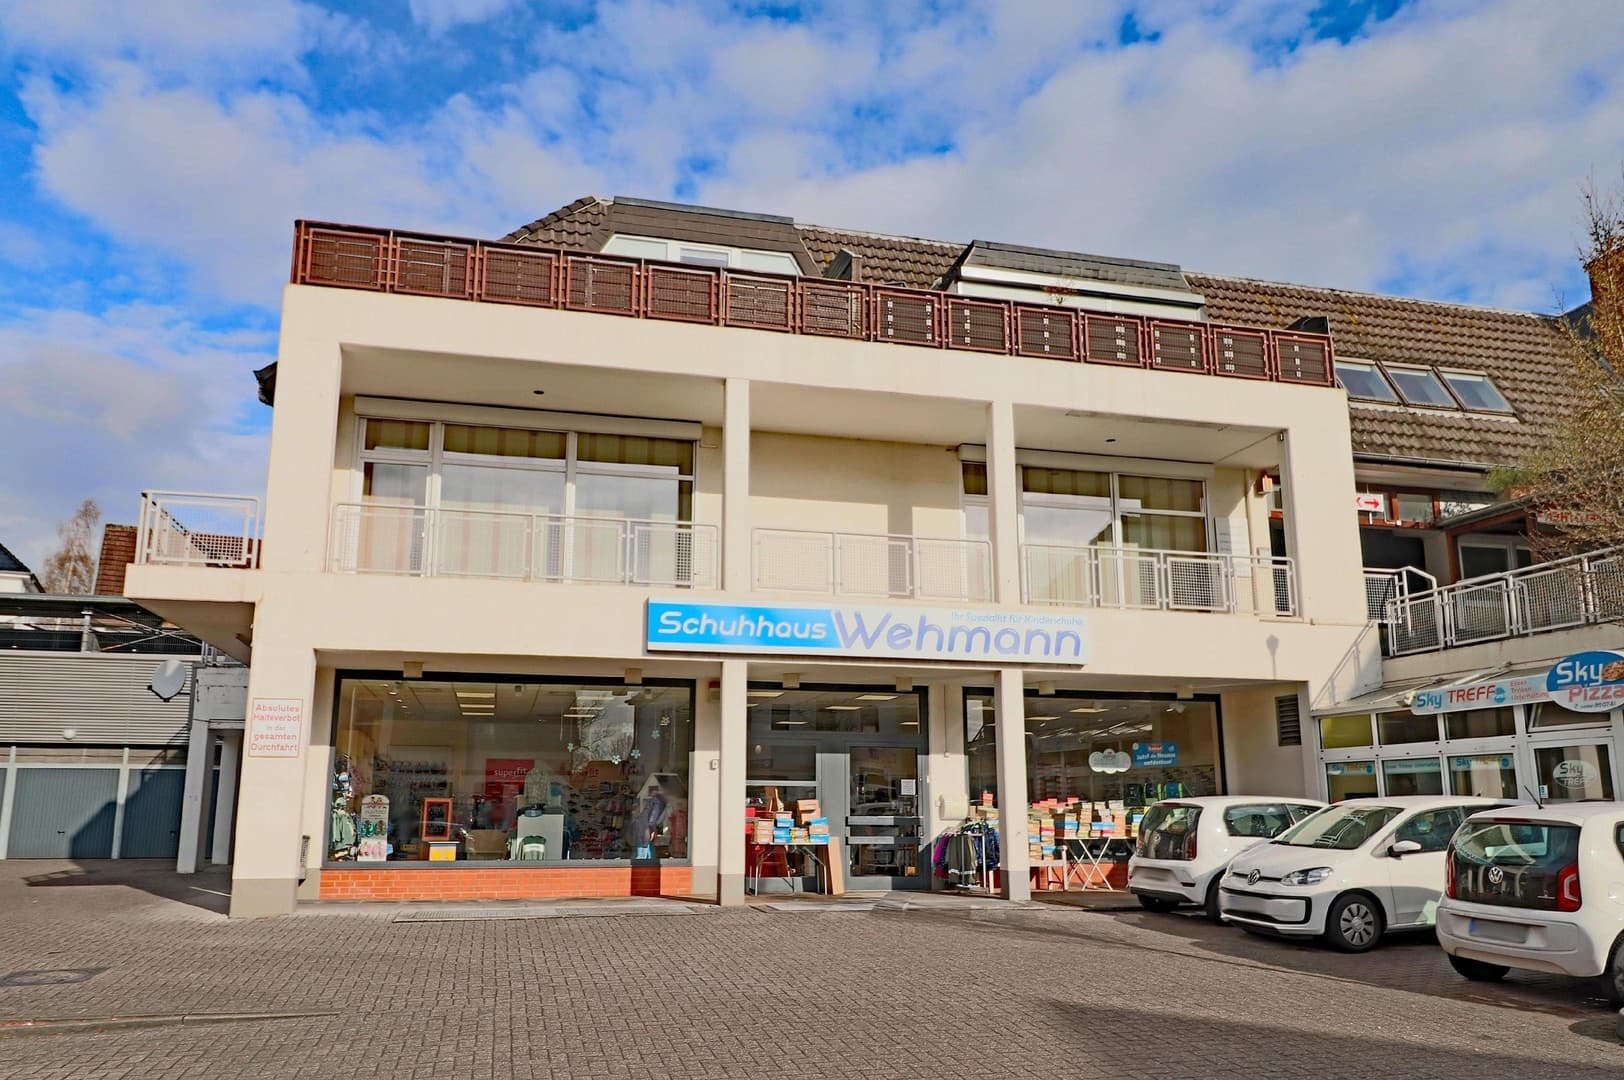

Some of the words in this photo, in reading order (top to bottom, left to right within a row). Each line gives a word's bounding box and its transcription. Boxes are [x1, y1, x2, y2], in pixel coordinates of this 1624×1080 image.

[658, 611, 827, 640] Schuhhaus
[834, 610, 1081, 657] Wehmann
[1556, 661, 1604, 686] Sky
[1416, 691, 1442, 708] Sky
[1447, 685, 1496, 704] TREFF
[1568, 684, 1624, 703] Pizza
[255, 704, 300, 713] Absolutes
[253, 713, 301, 722] Halteverbot
[494, 766, 528, 778] superfit
[1560, 763, 1584, 776] Sky
